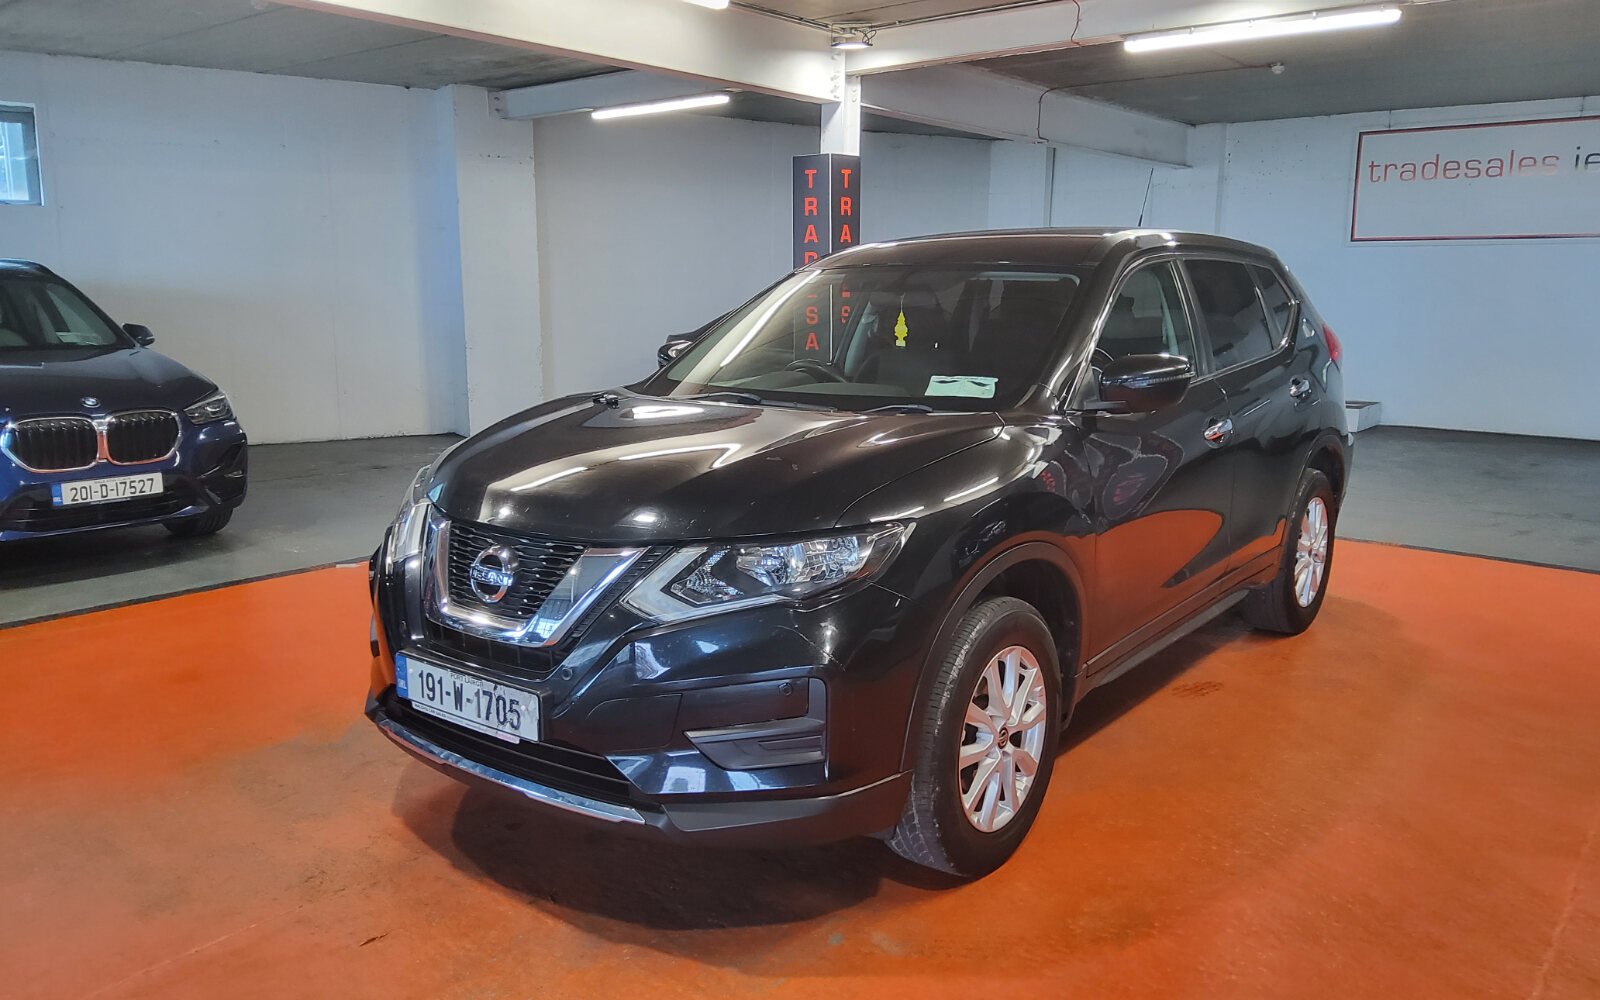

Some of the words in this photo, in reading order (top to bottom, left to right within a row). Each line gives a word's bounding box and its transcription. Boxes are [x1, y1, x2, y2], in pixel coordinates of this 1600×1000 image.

[1369, 150, 1560, 183] tradesales
[70, 478, 155, 502] 201-D-17527
[418, 669, 521, 731] 191-W-1705
